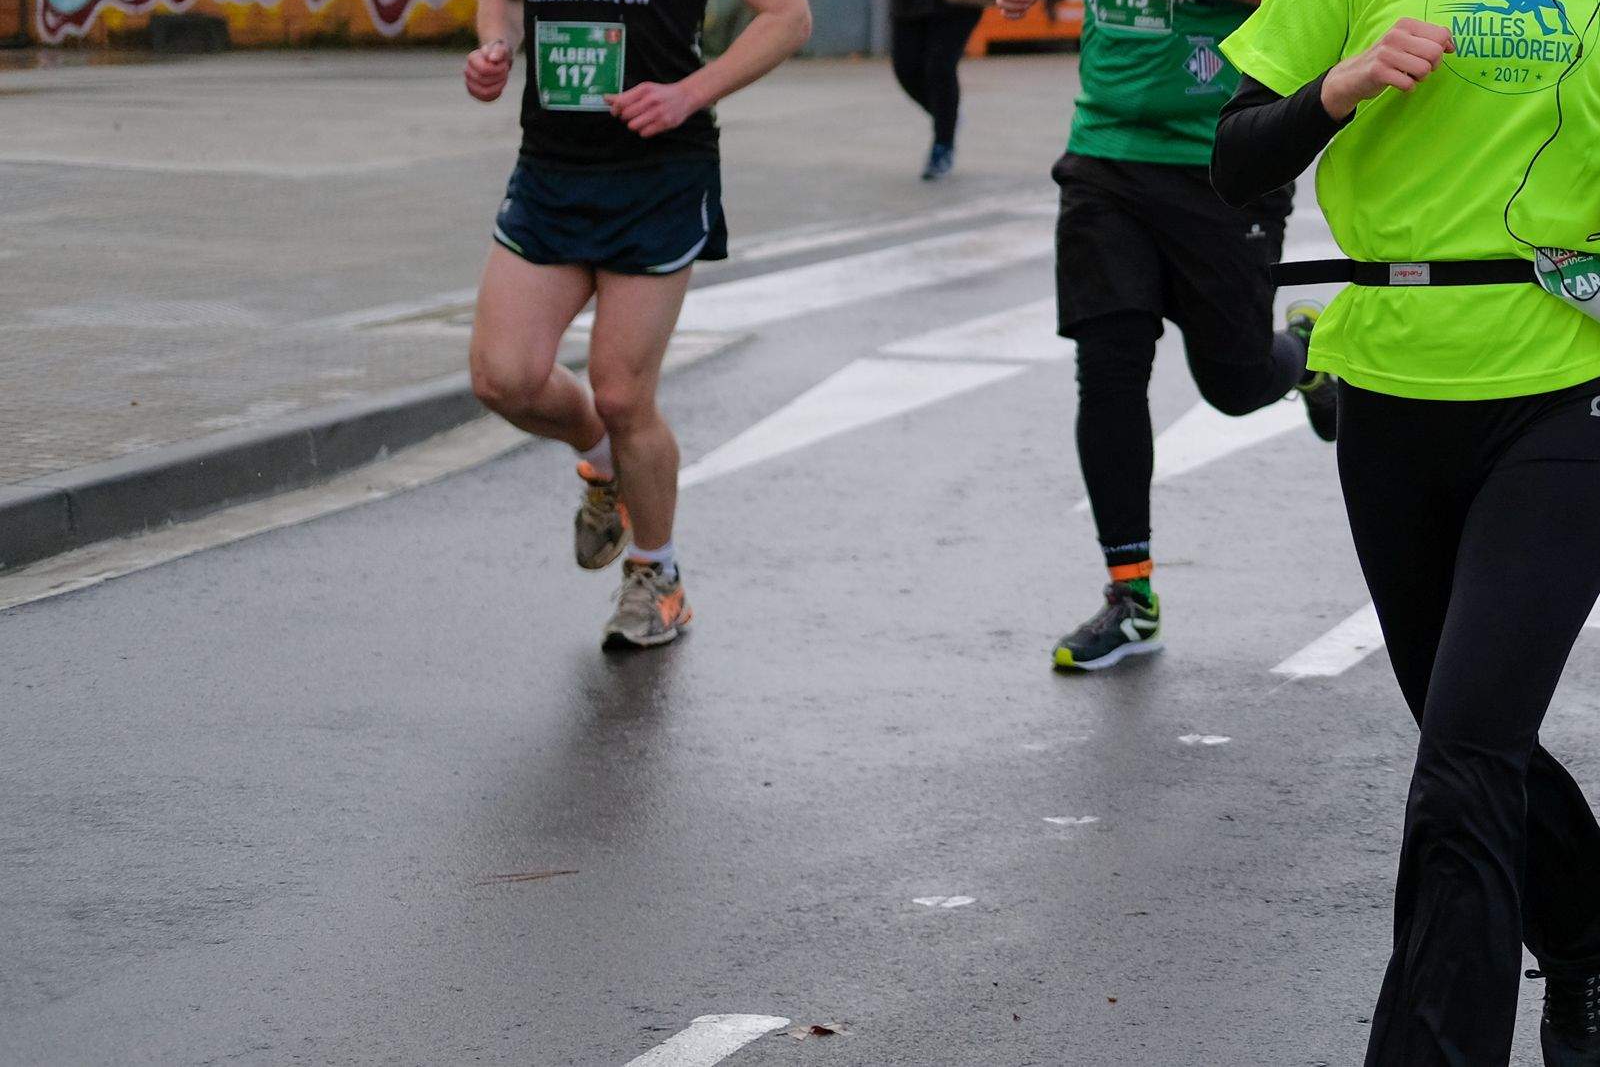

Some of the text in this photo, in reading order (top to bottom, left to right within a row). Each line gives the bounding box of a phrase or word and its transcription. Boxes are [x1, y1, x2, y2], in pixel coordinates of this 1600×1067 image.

[1452, 15, 1526, 37] MILLES
[548, 46, 607, 64] ALBERT
[1453, 36, 1574, 64] VALLDOREIX
[556, 63, 596, 87] 117
[1493, 67, 1531, 84] 2017
